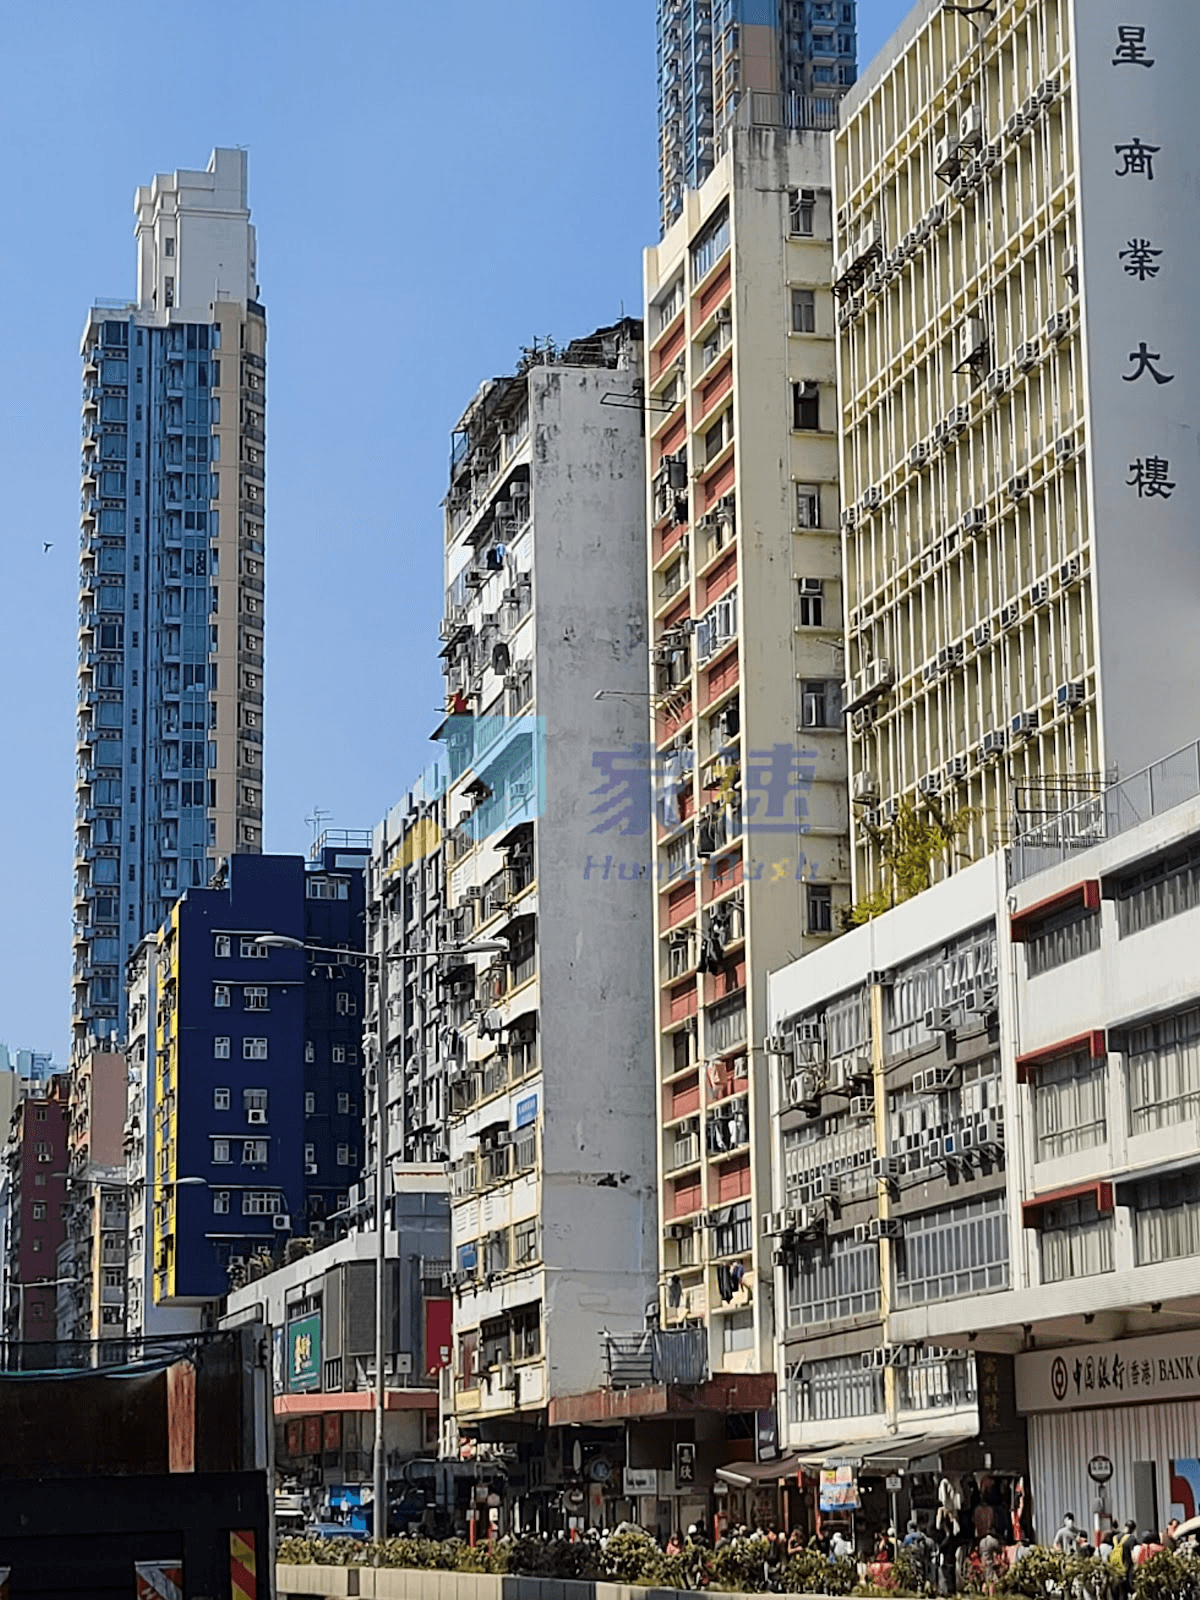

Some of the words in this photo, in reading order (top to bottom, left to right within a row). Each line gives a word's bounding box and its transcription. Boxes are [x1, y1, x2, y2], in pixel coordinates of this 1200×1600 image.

[1111, 25, 1176, 500] 星商業大樓
[1158, 1356, 1194, 1382] BANK
